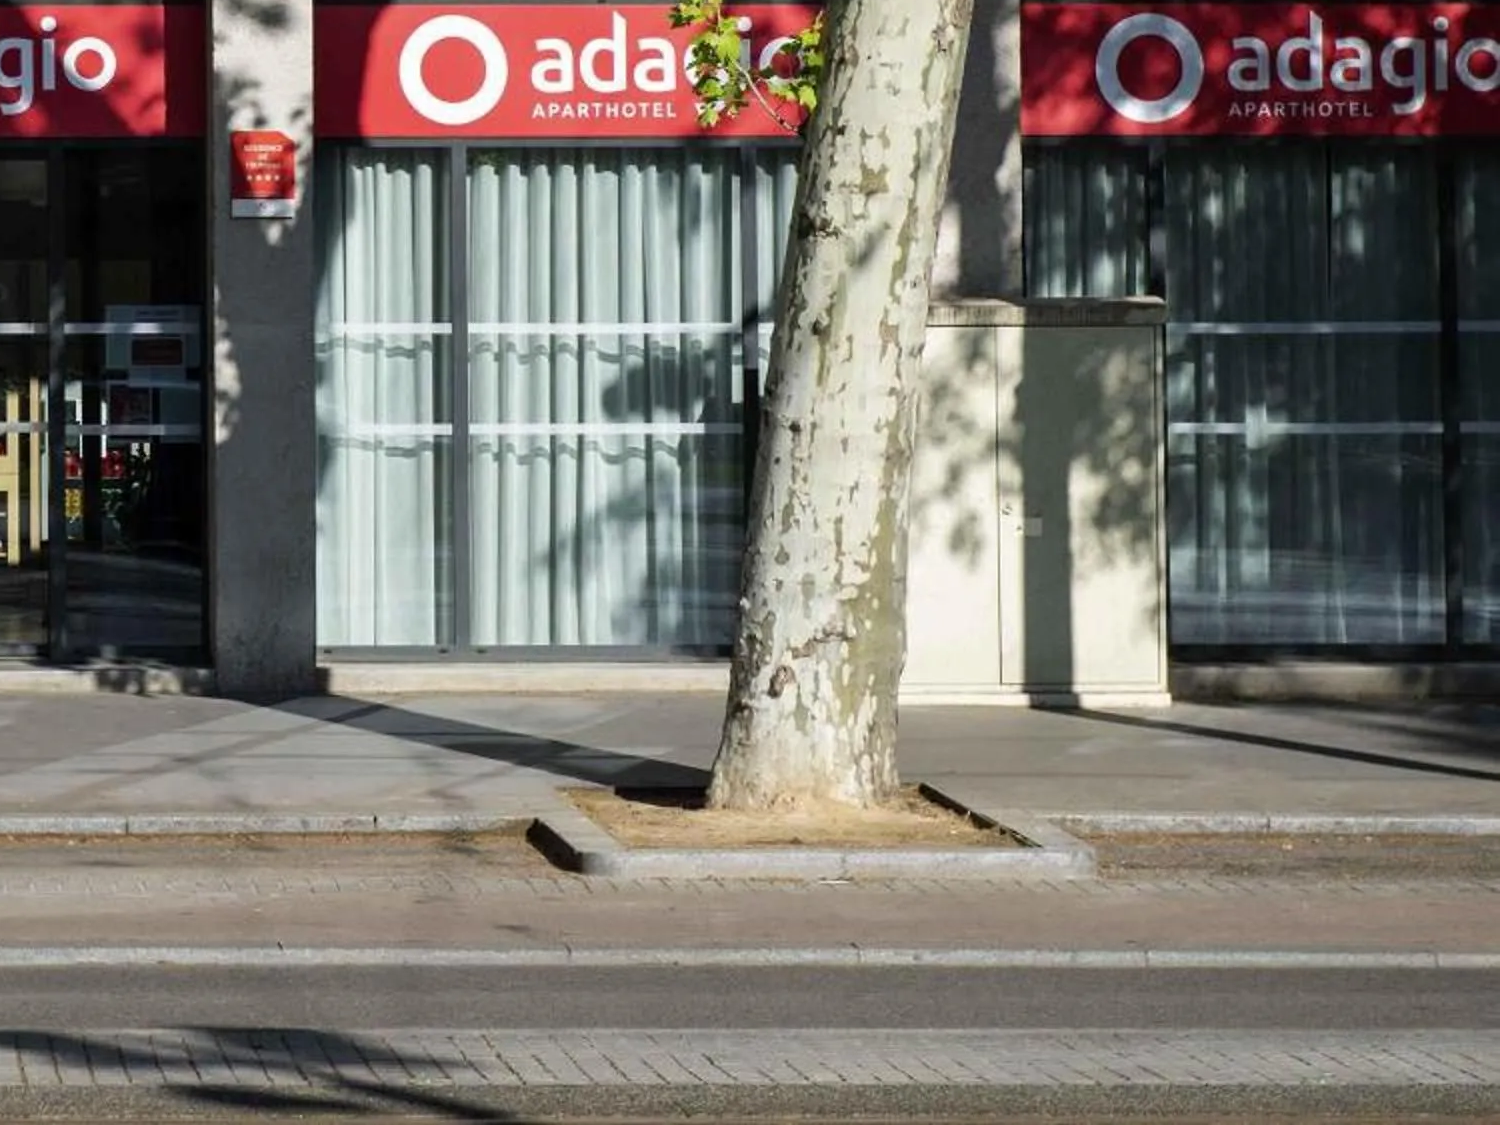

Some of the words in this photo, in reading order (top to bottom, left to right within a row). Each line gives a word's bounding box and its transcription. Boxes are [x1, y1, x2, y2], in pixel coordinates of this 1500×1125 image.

[1227, 11, 1500, 115] adagio
[531, 103, 676, 119] APARTHOTEL
[1228, 102, 1373, 118] APARTHOTEL
